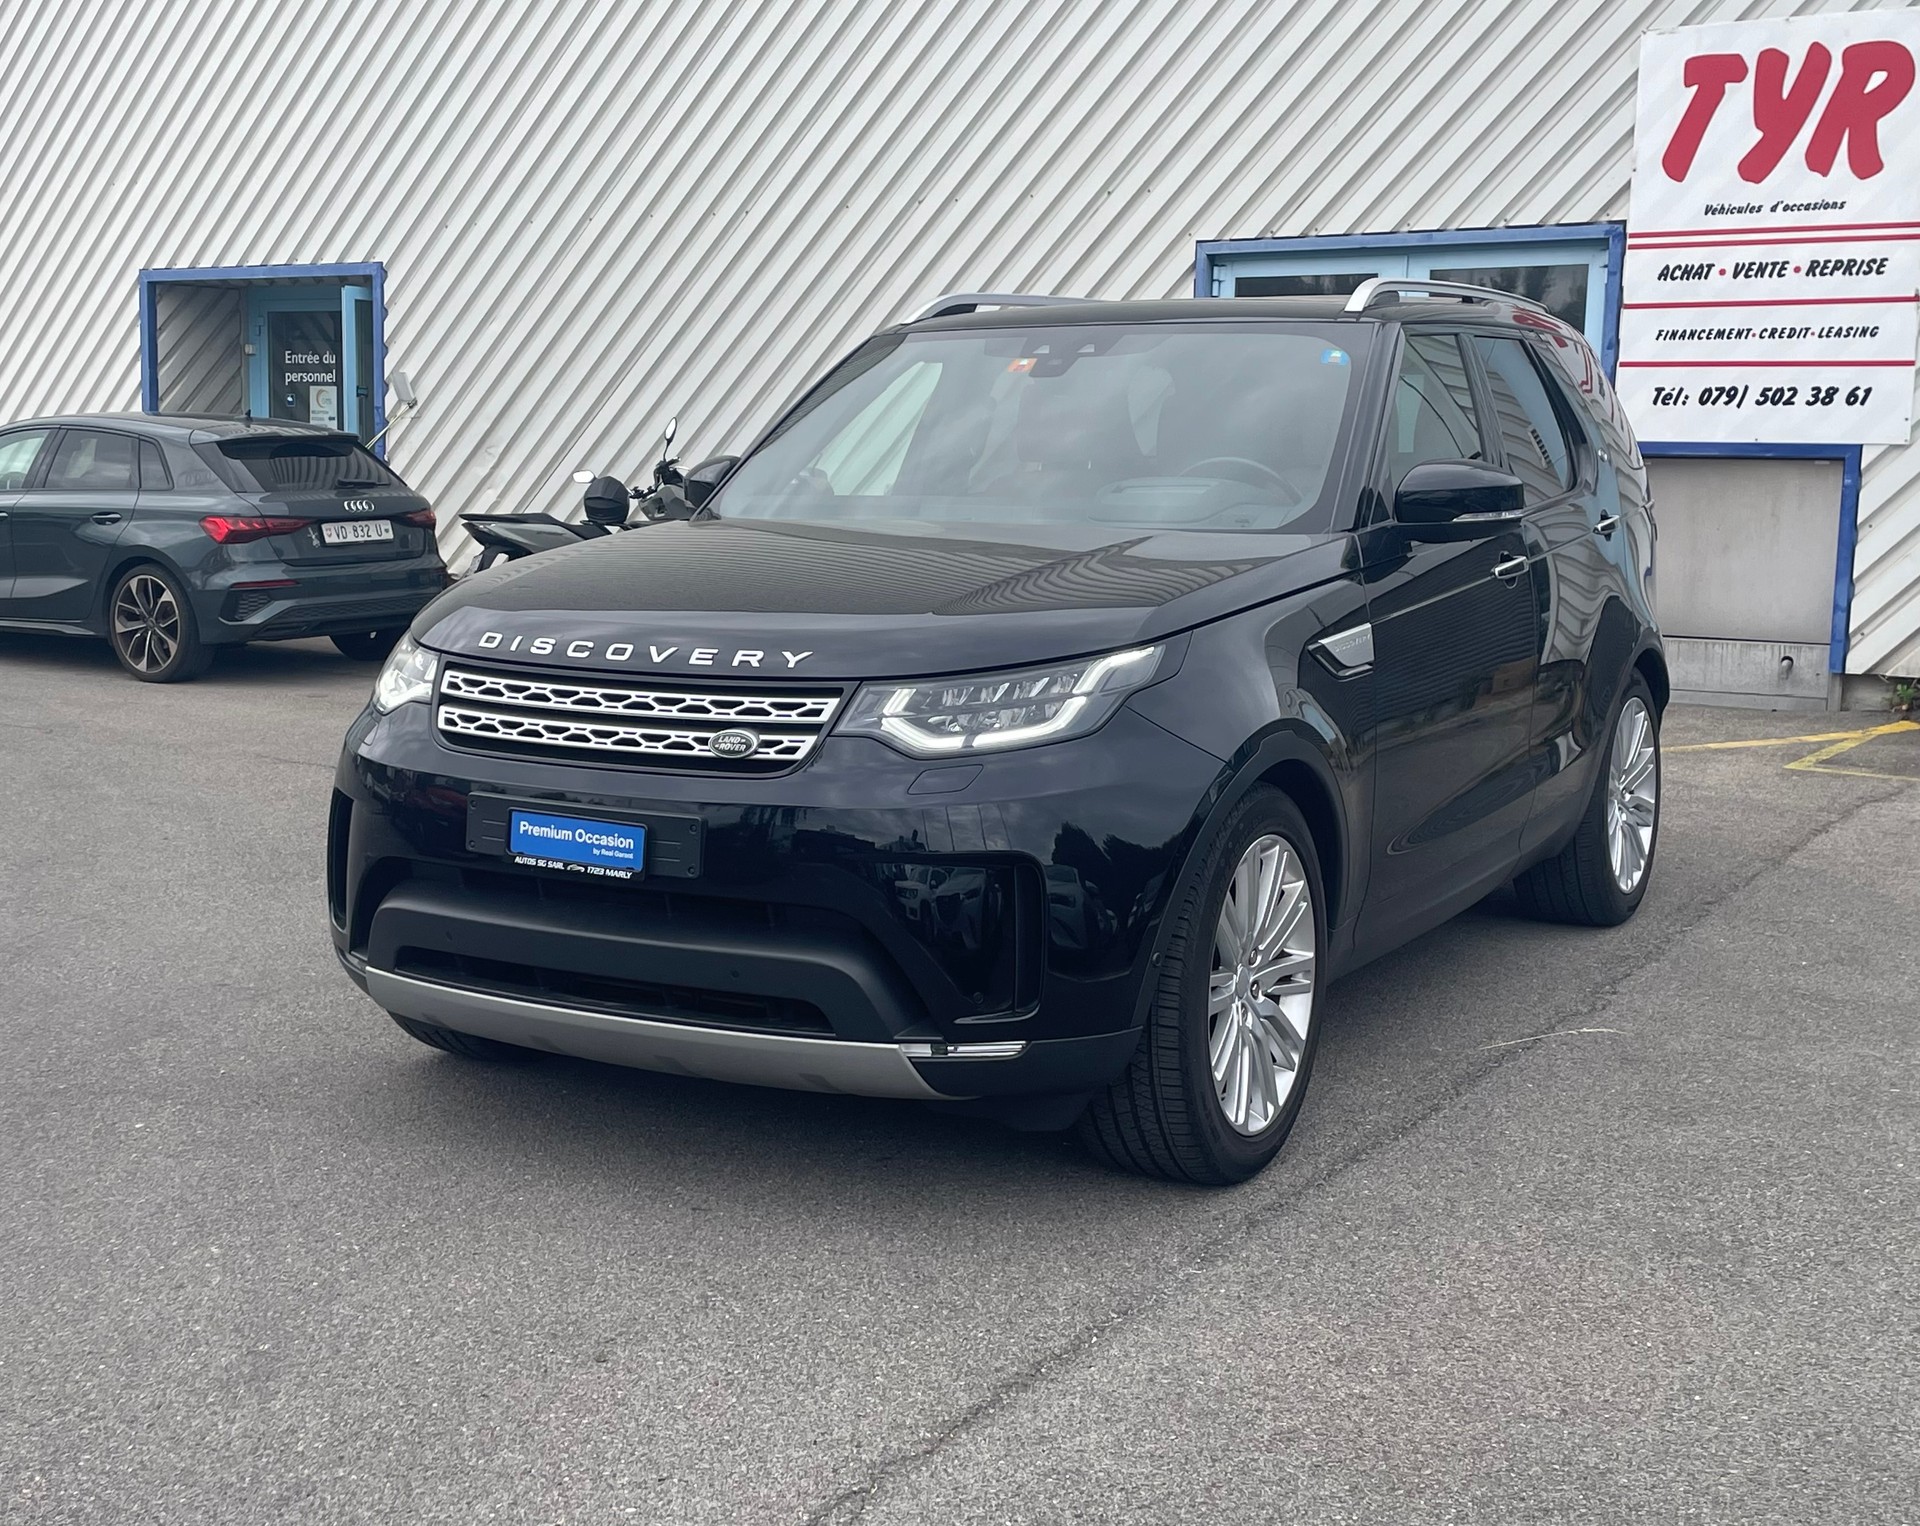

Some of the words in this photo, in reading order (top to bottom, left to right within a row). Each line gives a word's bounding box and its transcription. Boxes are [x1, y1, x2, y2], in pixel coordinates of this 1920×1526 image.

[1662, 40, 1915, 184] TYR
[1704, 203, 1763, 216] Véhicules
[1770, 200, 1847, 213] d'occasions
[1657, 263, 1715, 281] ACHAT
[1732, 260, 1790, 279] VENTE
[1805, 257, 1889, 277] REPRISE
[1818, 326, 1880, 338] LEASING
[285, 350, 320, 364] Entrée
[322, 350, 336, 364] du
[285, 368, 336, 386] personnel
[1652, 387, 1690, 406] Tél:
[1755, 387, 1799, 406] 502
[1805, 387, 1839, 406] 38
[1845, 387, 1873, 406] 61
[478, 631, 814, 668] DISCOVERY
[718, 736, 741, 744] LAND
[718, 743, 747, 752] ROVER
[520, 821, 572, 841] Premium
[575, 829, 634, 849] Occasion
[593, 848, 600, 856] by
[515, 856, 536, 866] AUTOS
[586, 866, 605, 876] 1723
[605, 869, 632, 879] MARLY
